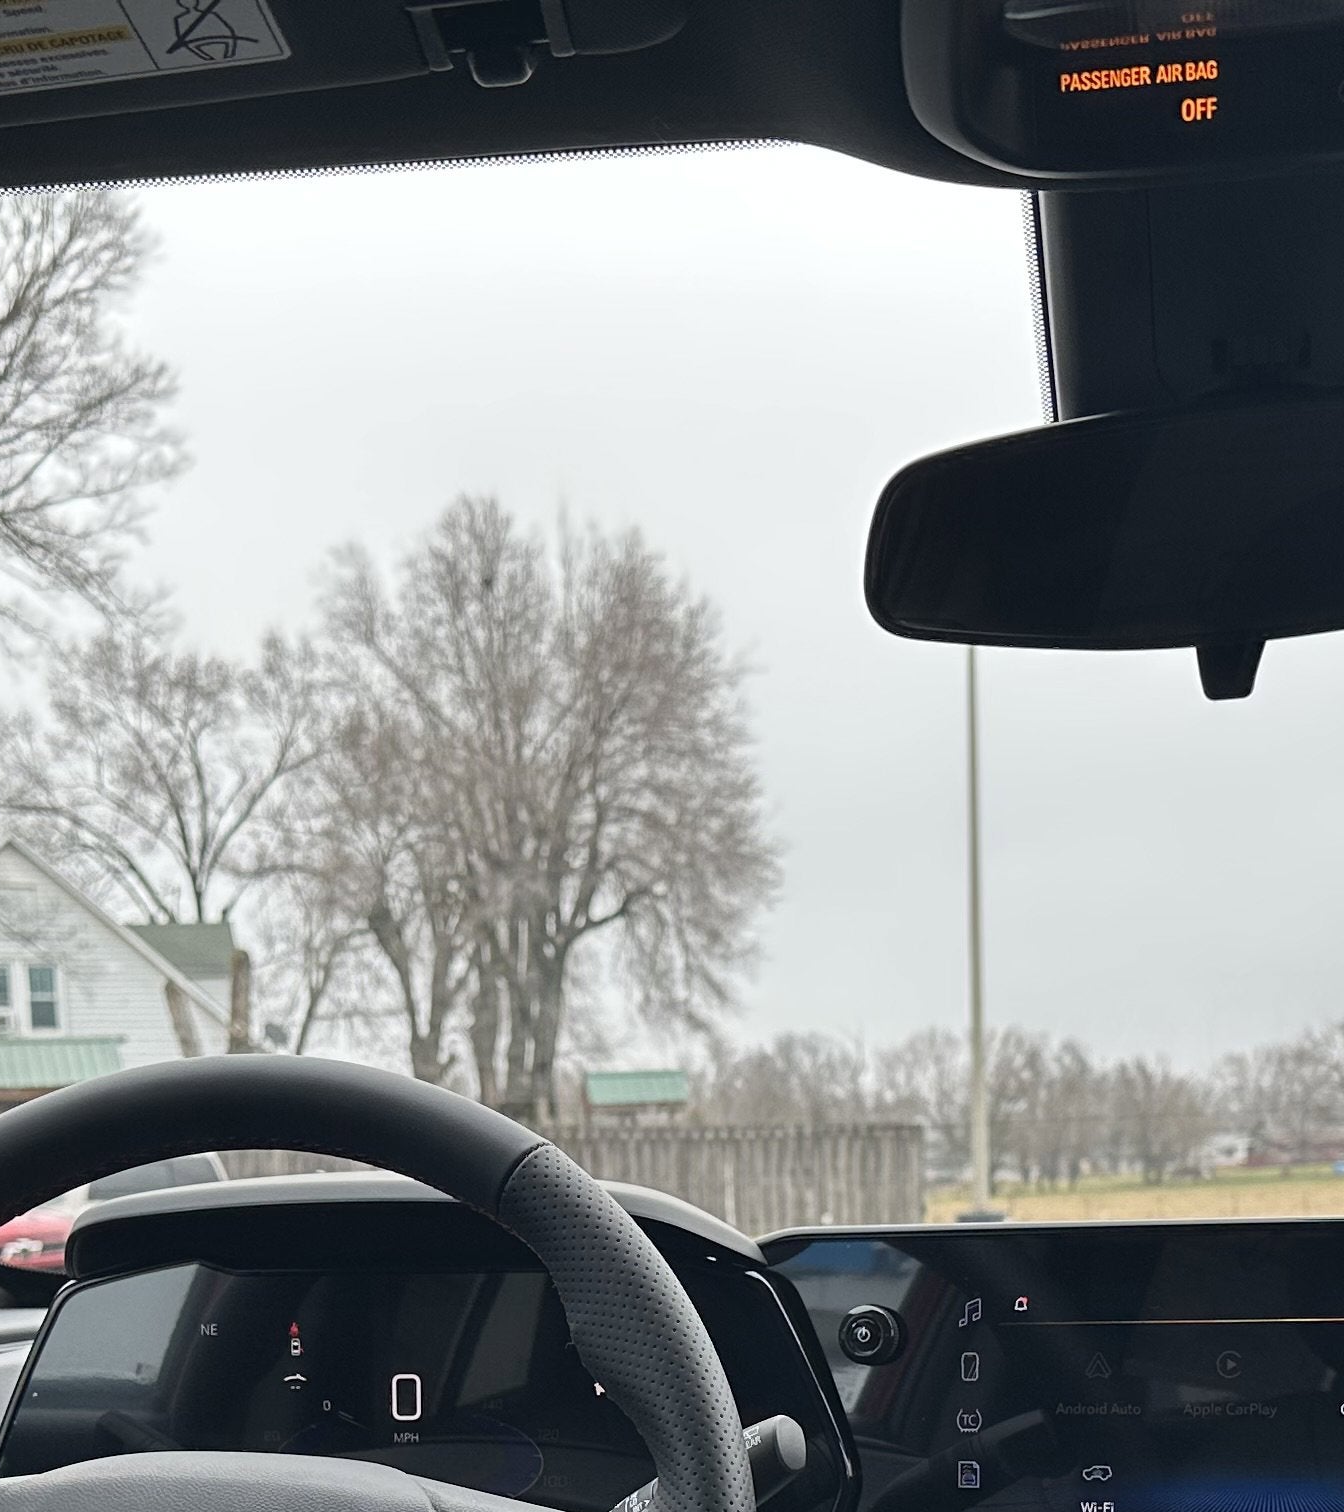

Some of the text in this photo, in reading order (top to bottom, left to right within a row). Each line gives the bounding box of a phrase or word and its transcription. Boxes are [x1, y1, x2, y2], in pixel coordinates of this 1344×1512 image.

[49, 30, 125, 49] CAPOTAGE
[1060, 59, 1218, 92] PASSENGER AIR BAG
[1181, 97, 1218, 122] OFF
[200, 1324, 219, 1337] NE
[391, 1373, 422, 1421] 0
[1056, 1402, 1142, 1416] Android Auto
[1183, 1402, 1278, 1419] Apple CarPlay
[393, 1432, 420, 1444] MPH
